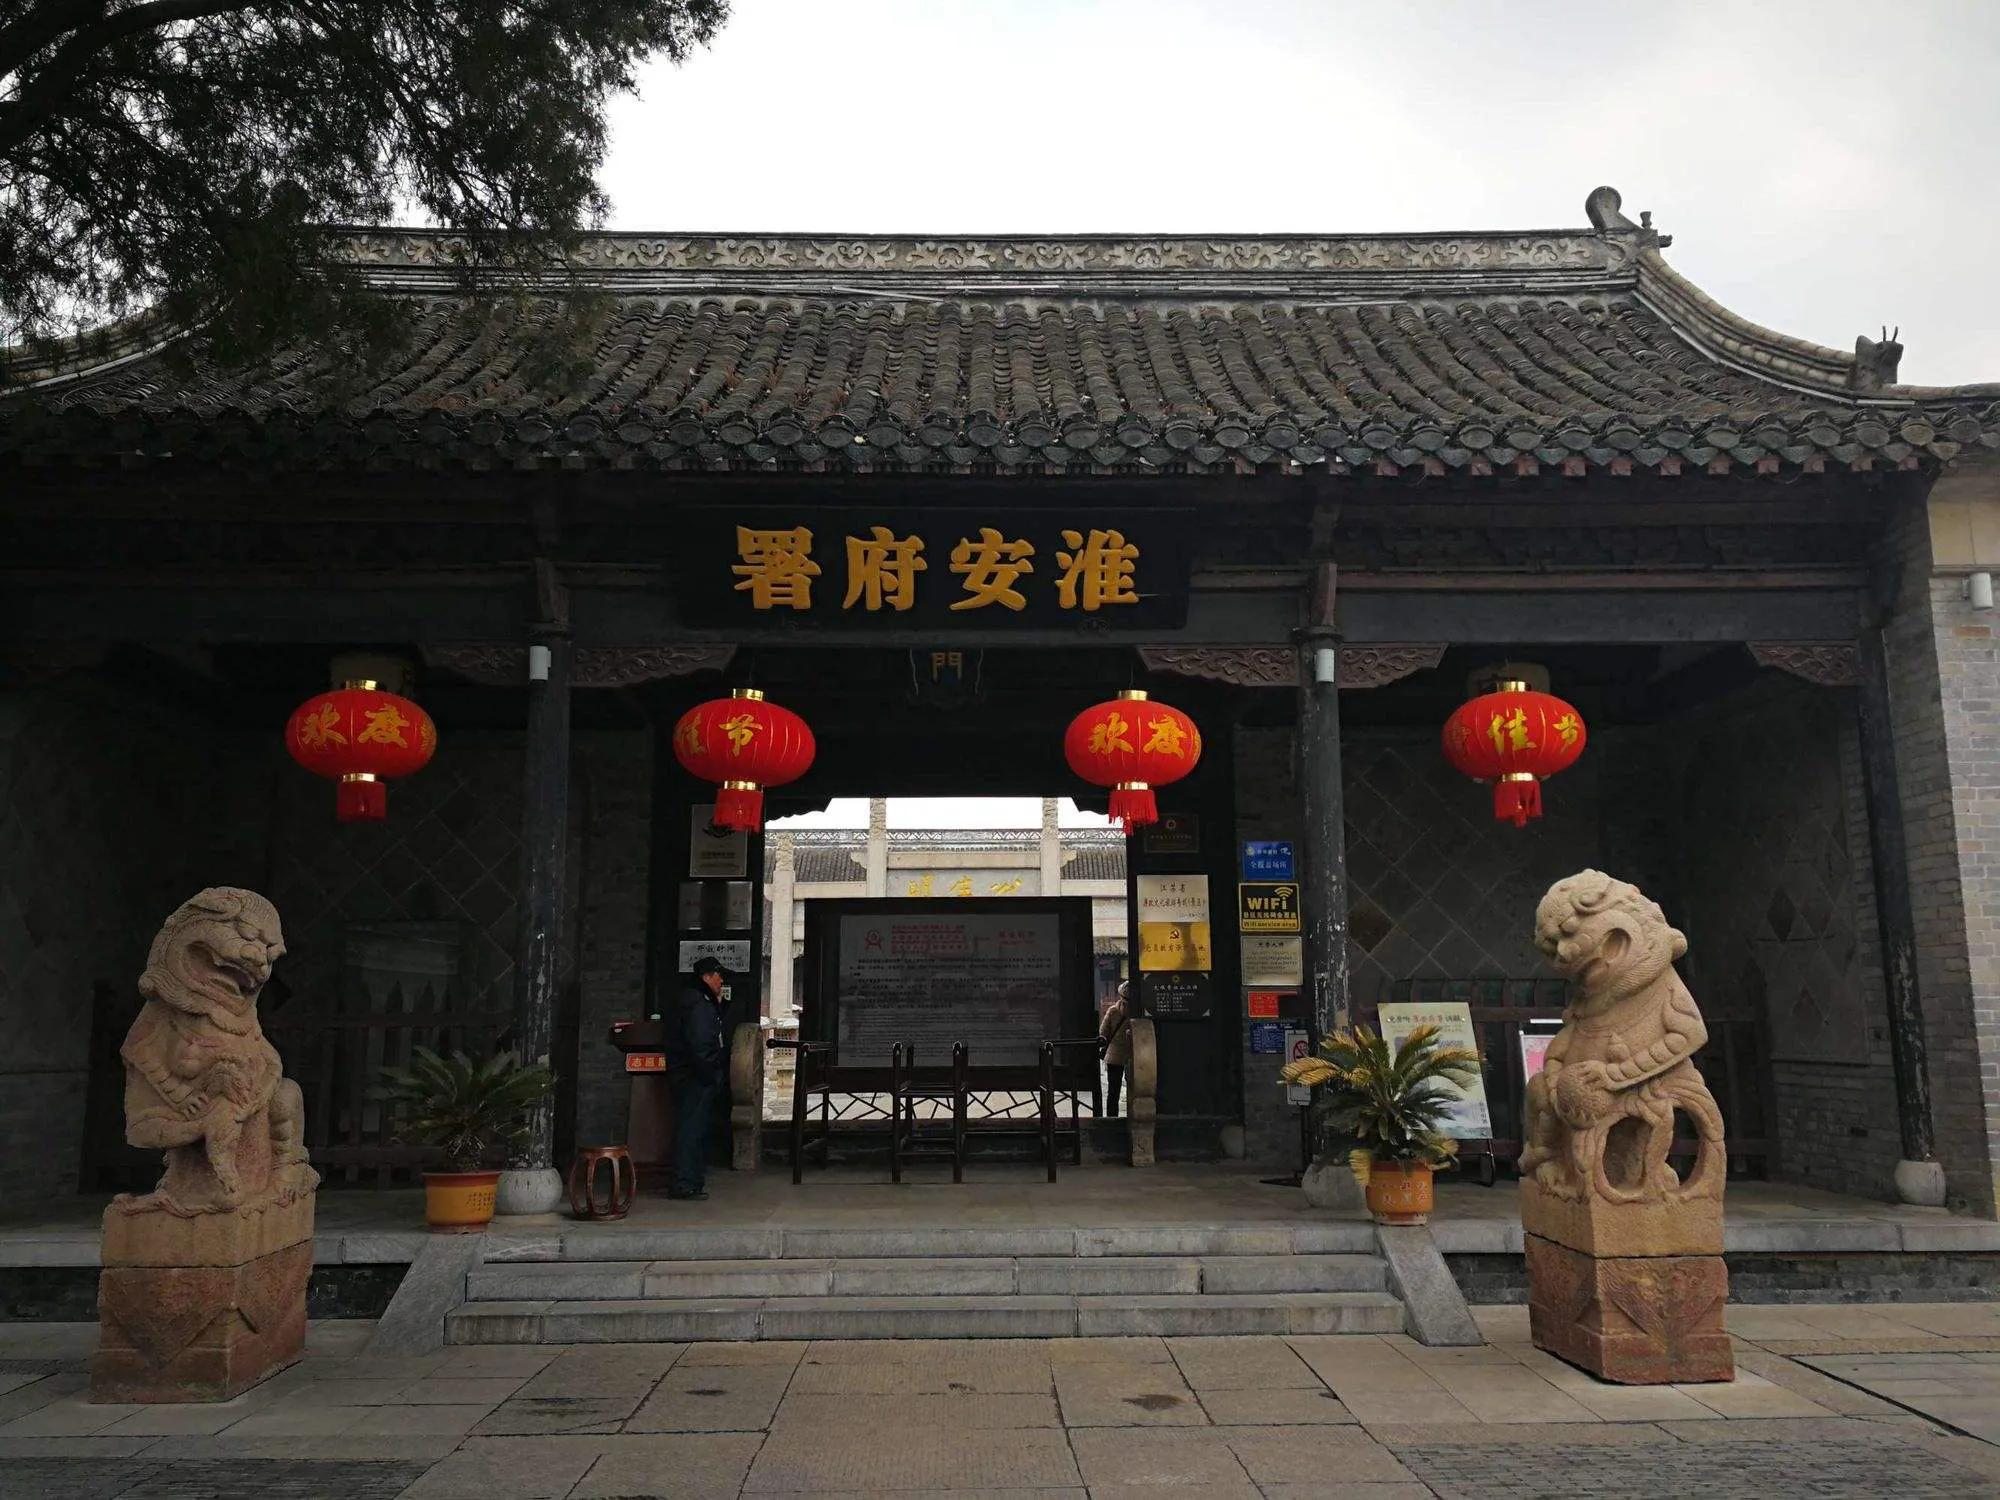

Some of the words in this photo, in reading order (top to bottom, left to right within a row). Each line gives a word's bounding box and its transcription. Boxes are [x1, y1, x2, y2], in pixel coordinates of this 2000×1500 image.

[930, 651, 962, 681] 門
[302, 702, 410, 749] 欢度
[1088, 712, 1187, 759] 欢度
[1487, 707, 1580, 755] 佳节
